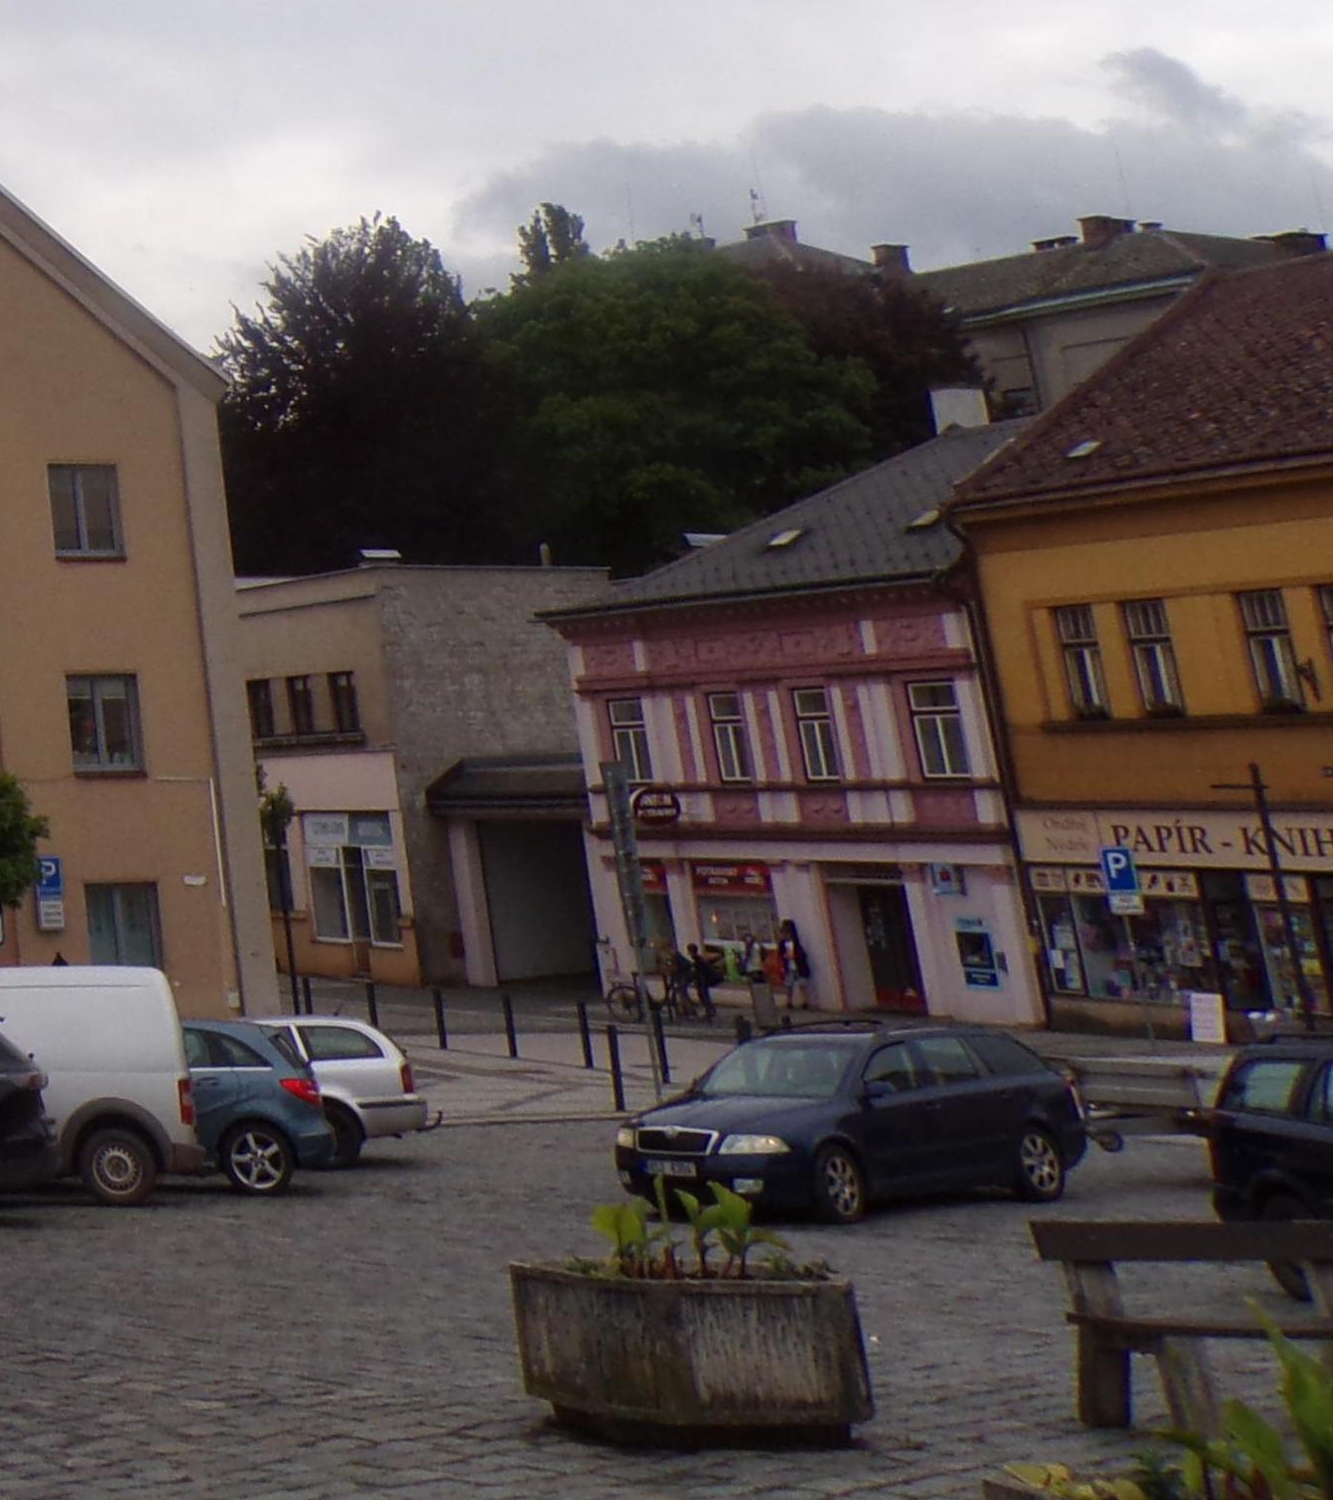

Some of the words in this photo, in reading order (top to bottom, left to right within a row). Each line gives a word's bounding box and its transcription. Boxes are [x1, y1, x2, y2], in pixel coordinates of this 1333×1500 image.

[1111, 819, 1215, 854] PAPÍR
[40, 861, 56, 885] P
[1106, 852, 1127, 879] P
